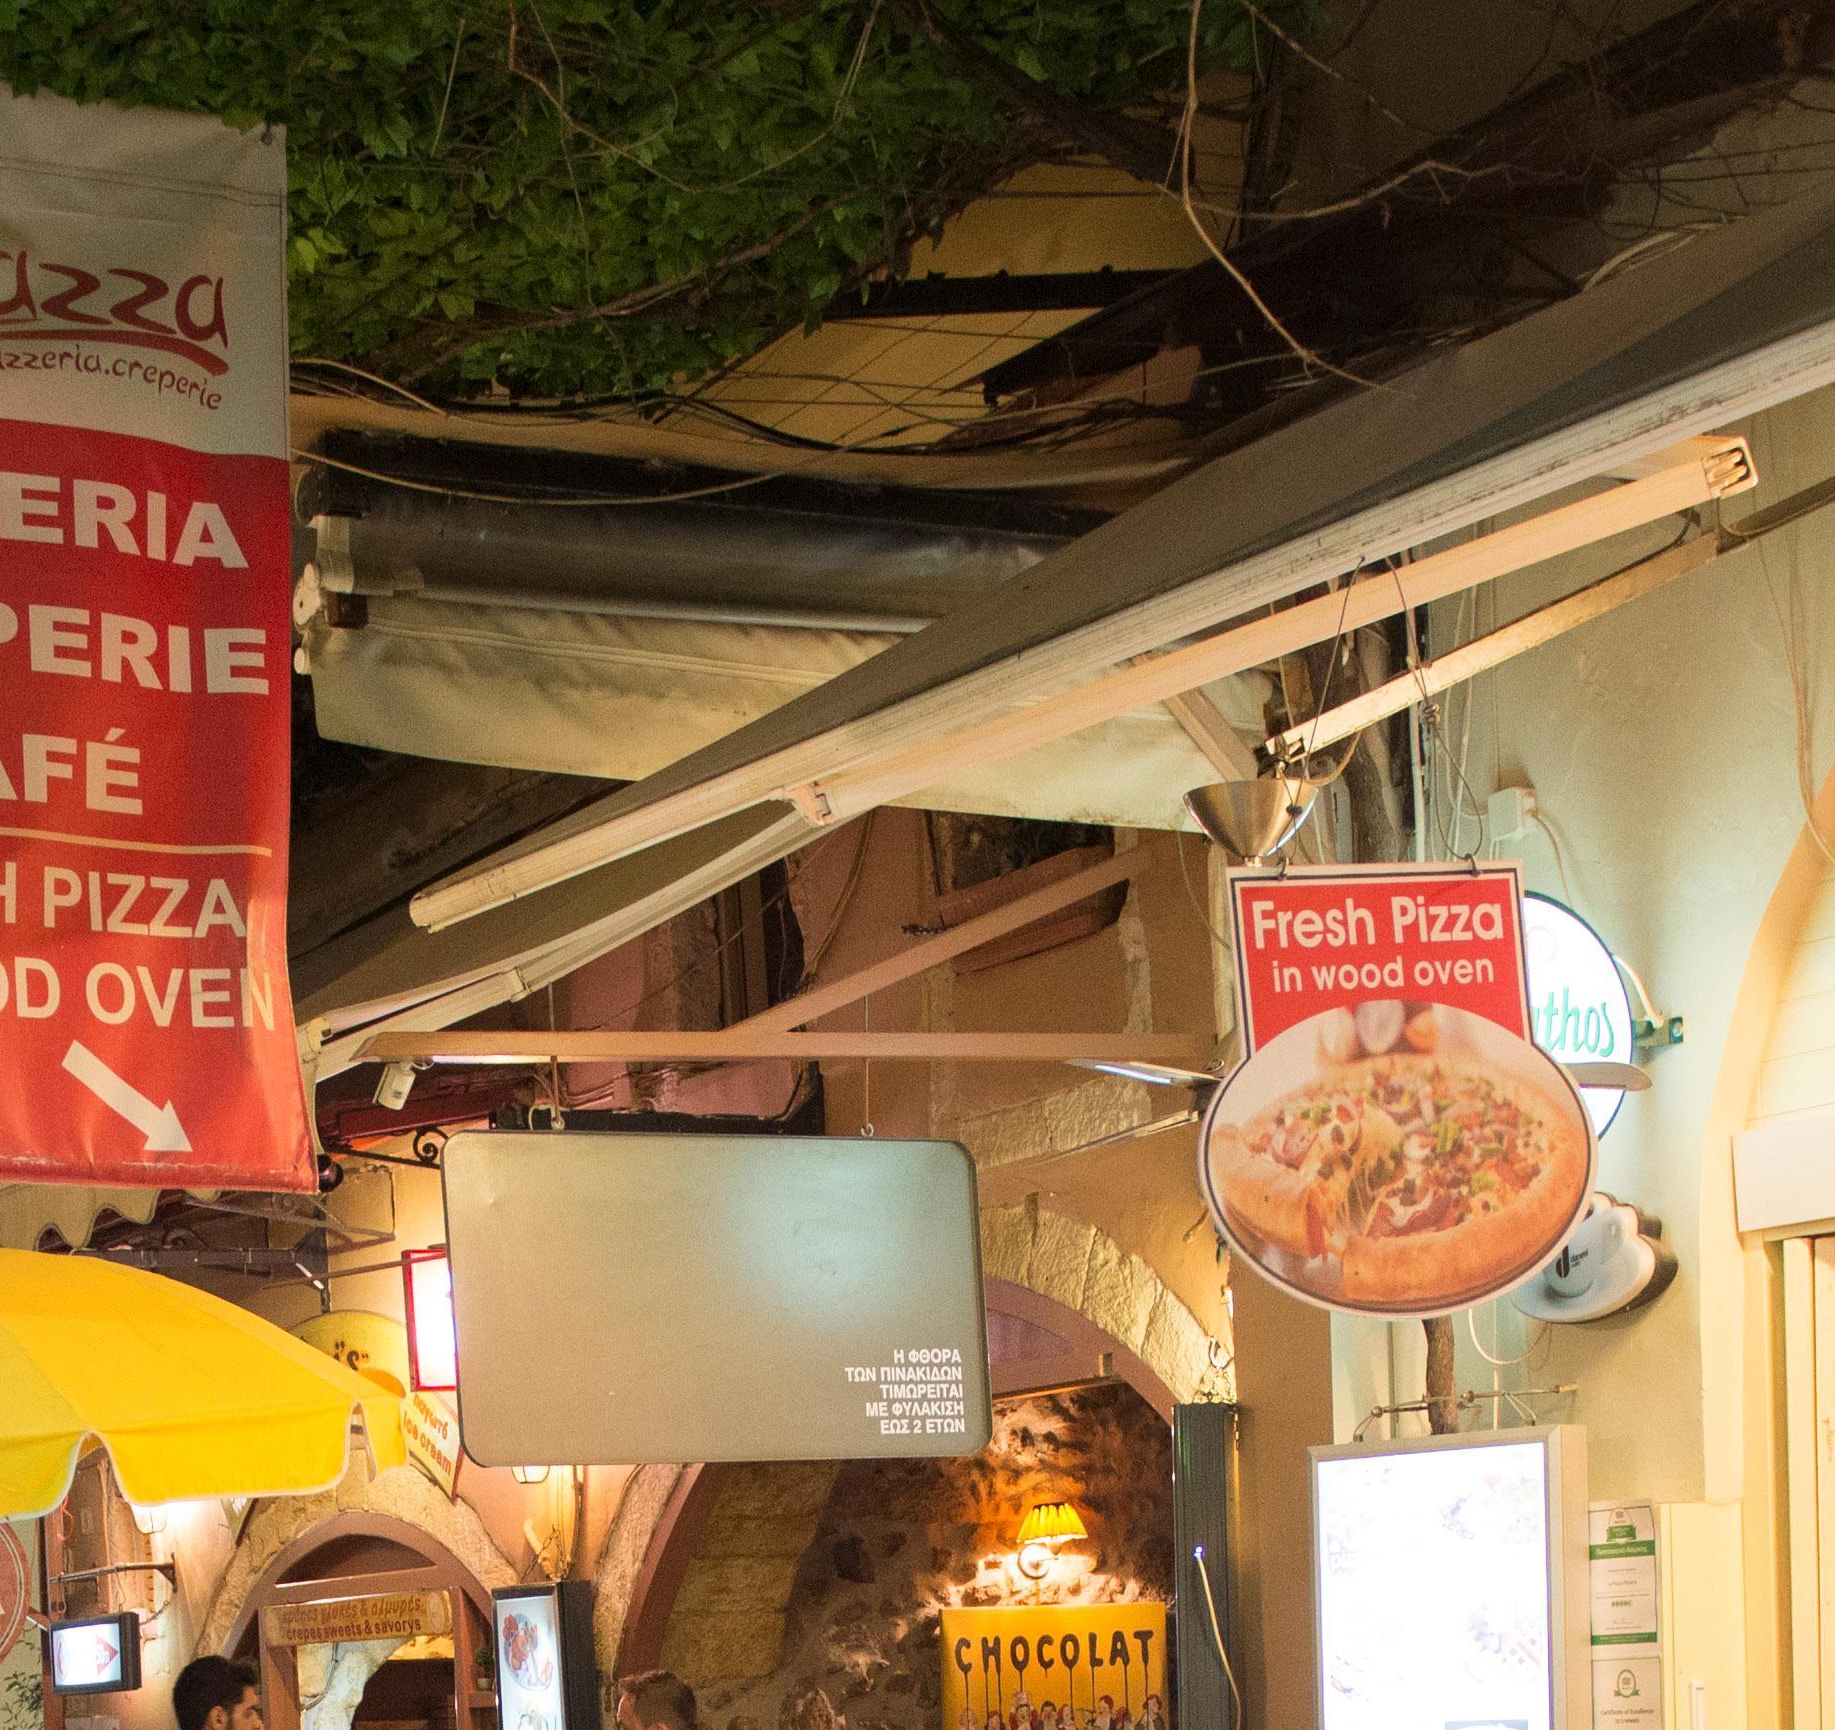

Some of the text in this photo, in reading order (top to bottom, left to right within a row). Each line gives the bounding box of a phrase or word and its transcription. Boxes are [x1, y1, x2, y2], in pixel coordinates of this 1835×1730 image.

[43, 865, 248, 938] PIZZA
[1251, 895, 1504, 951] Fresh Pizza
[1272, 955, 1495, 993] in wood oven
[85, 962, 274, 1031] OVEN
[1533, 986, 1616, 1058] thos
[893, 1349, 962, 1364] Η ΦΘΟΡΑ
[845, 1366, 962, 1382] ΤΩΝ ΠΙΝΑΚΙΔΩΝ
[880, 1384, 963, 1399] ΤΙΜΩΡΕΙΤΑΙ
[866, 1401, 964, 1417] ΜΕ ΦΥΛΑΚΙΣΗ
[880, 1419, 965, 1434] ΕΩΣ 2 ΕΤΩΝ
[364, 1620, 372, 1634] &
[375, 1619, 420, 1637] savorys
[954, 1629, 1154, 1674] CHOCOLAT
